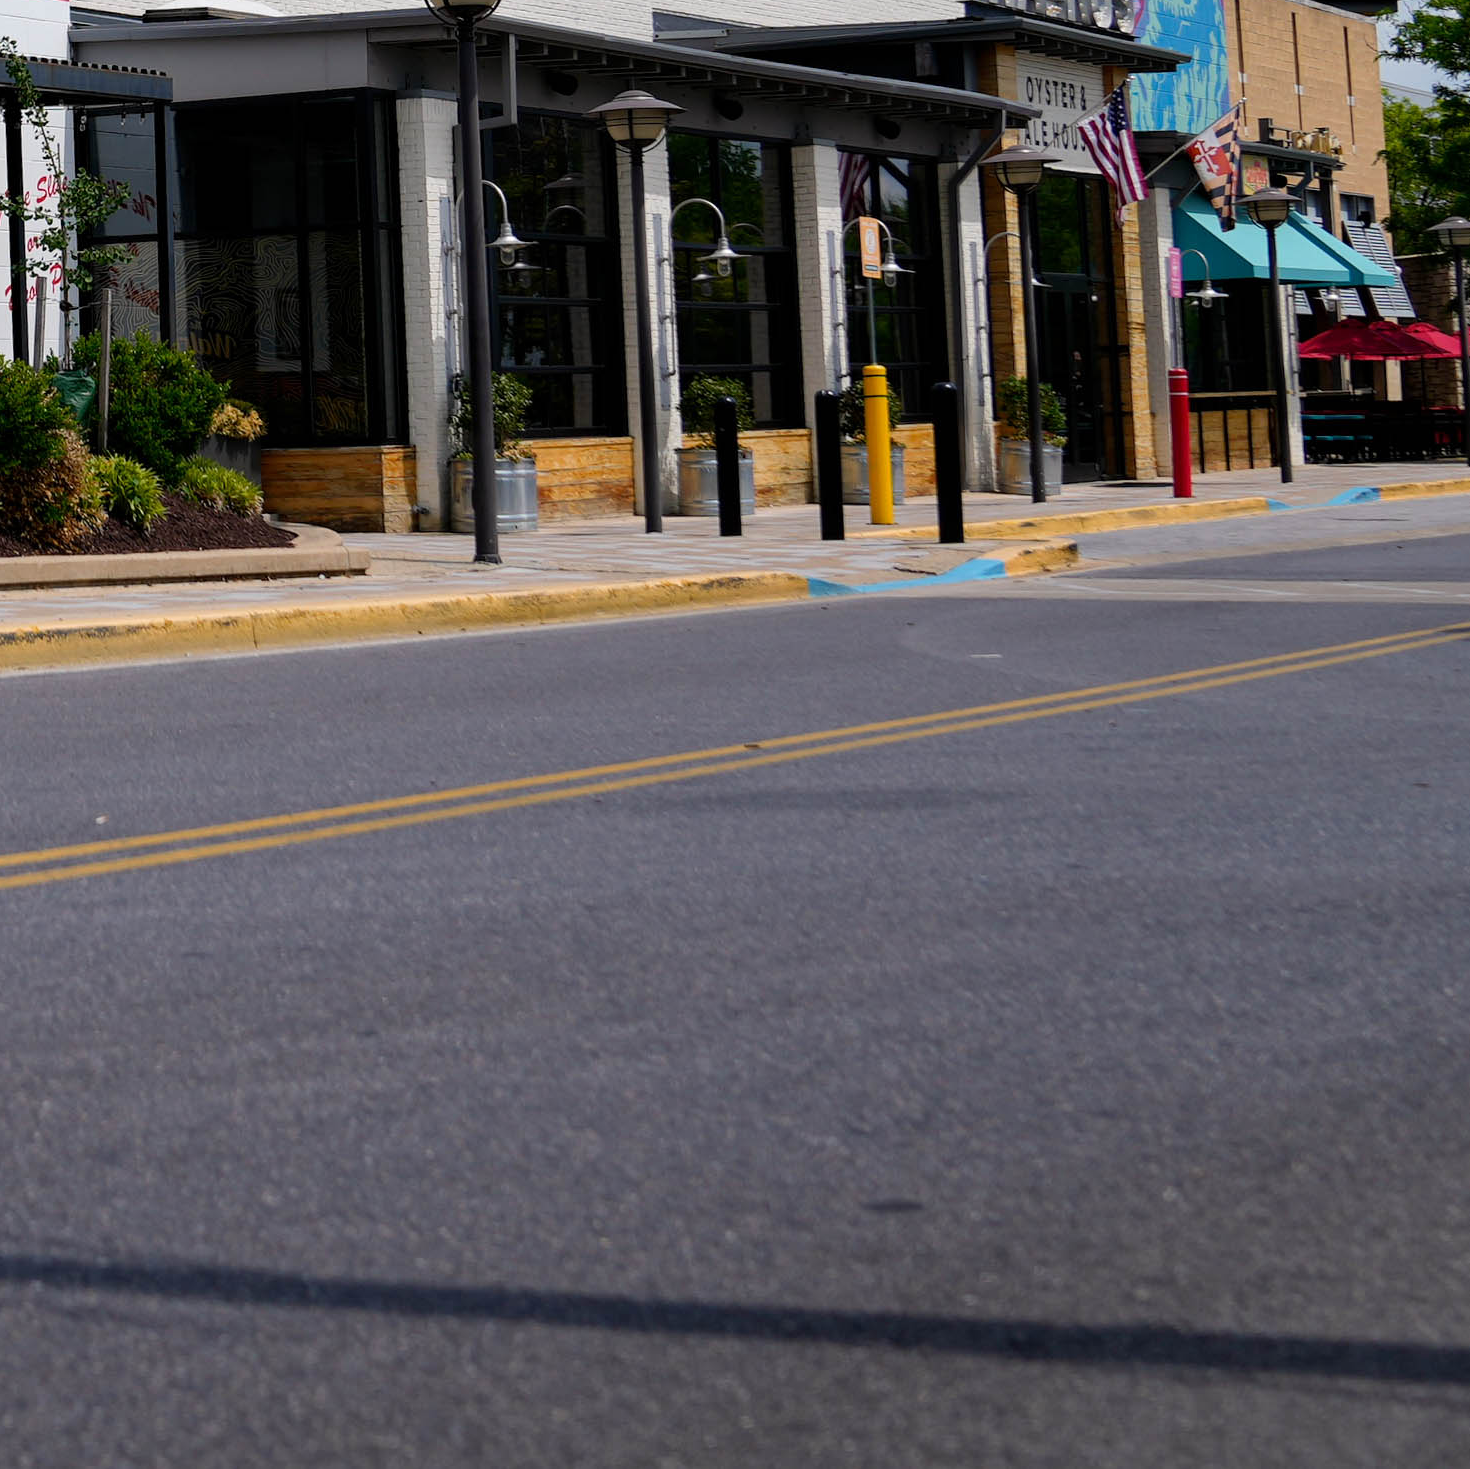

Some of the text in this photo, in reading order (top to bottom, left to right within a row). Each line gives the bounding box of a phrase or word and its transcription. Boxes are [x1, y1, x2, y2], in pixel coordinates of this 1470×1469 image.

[1026, 76, 1087, 111] OYSTER &
[1024, 119, 1087, 152] ALE HOU
